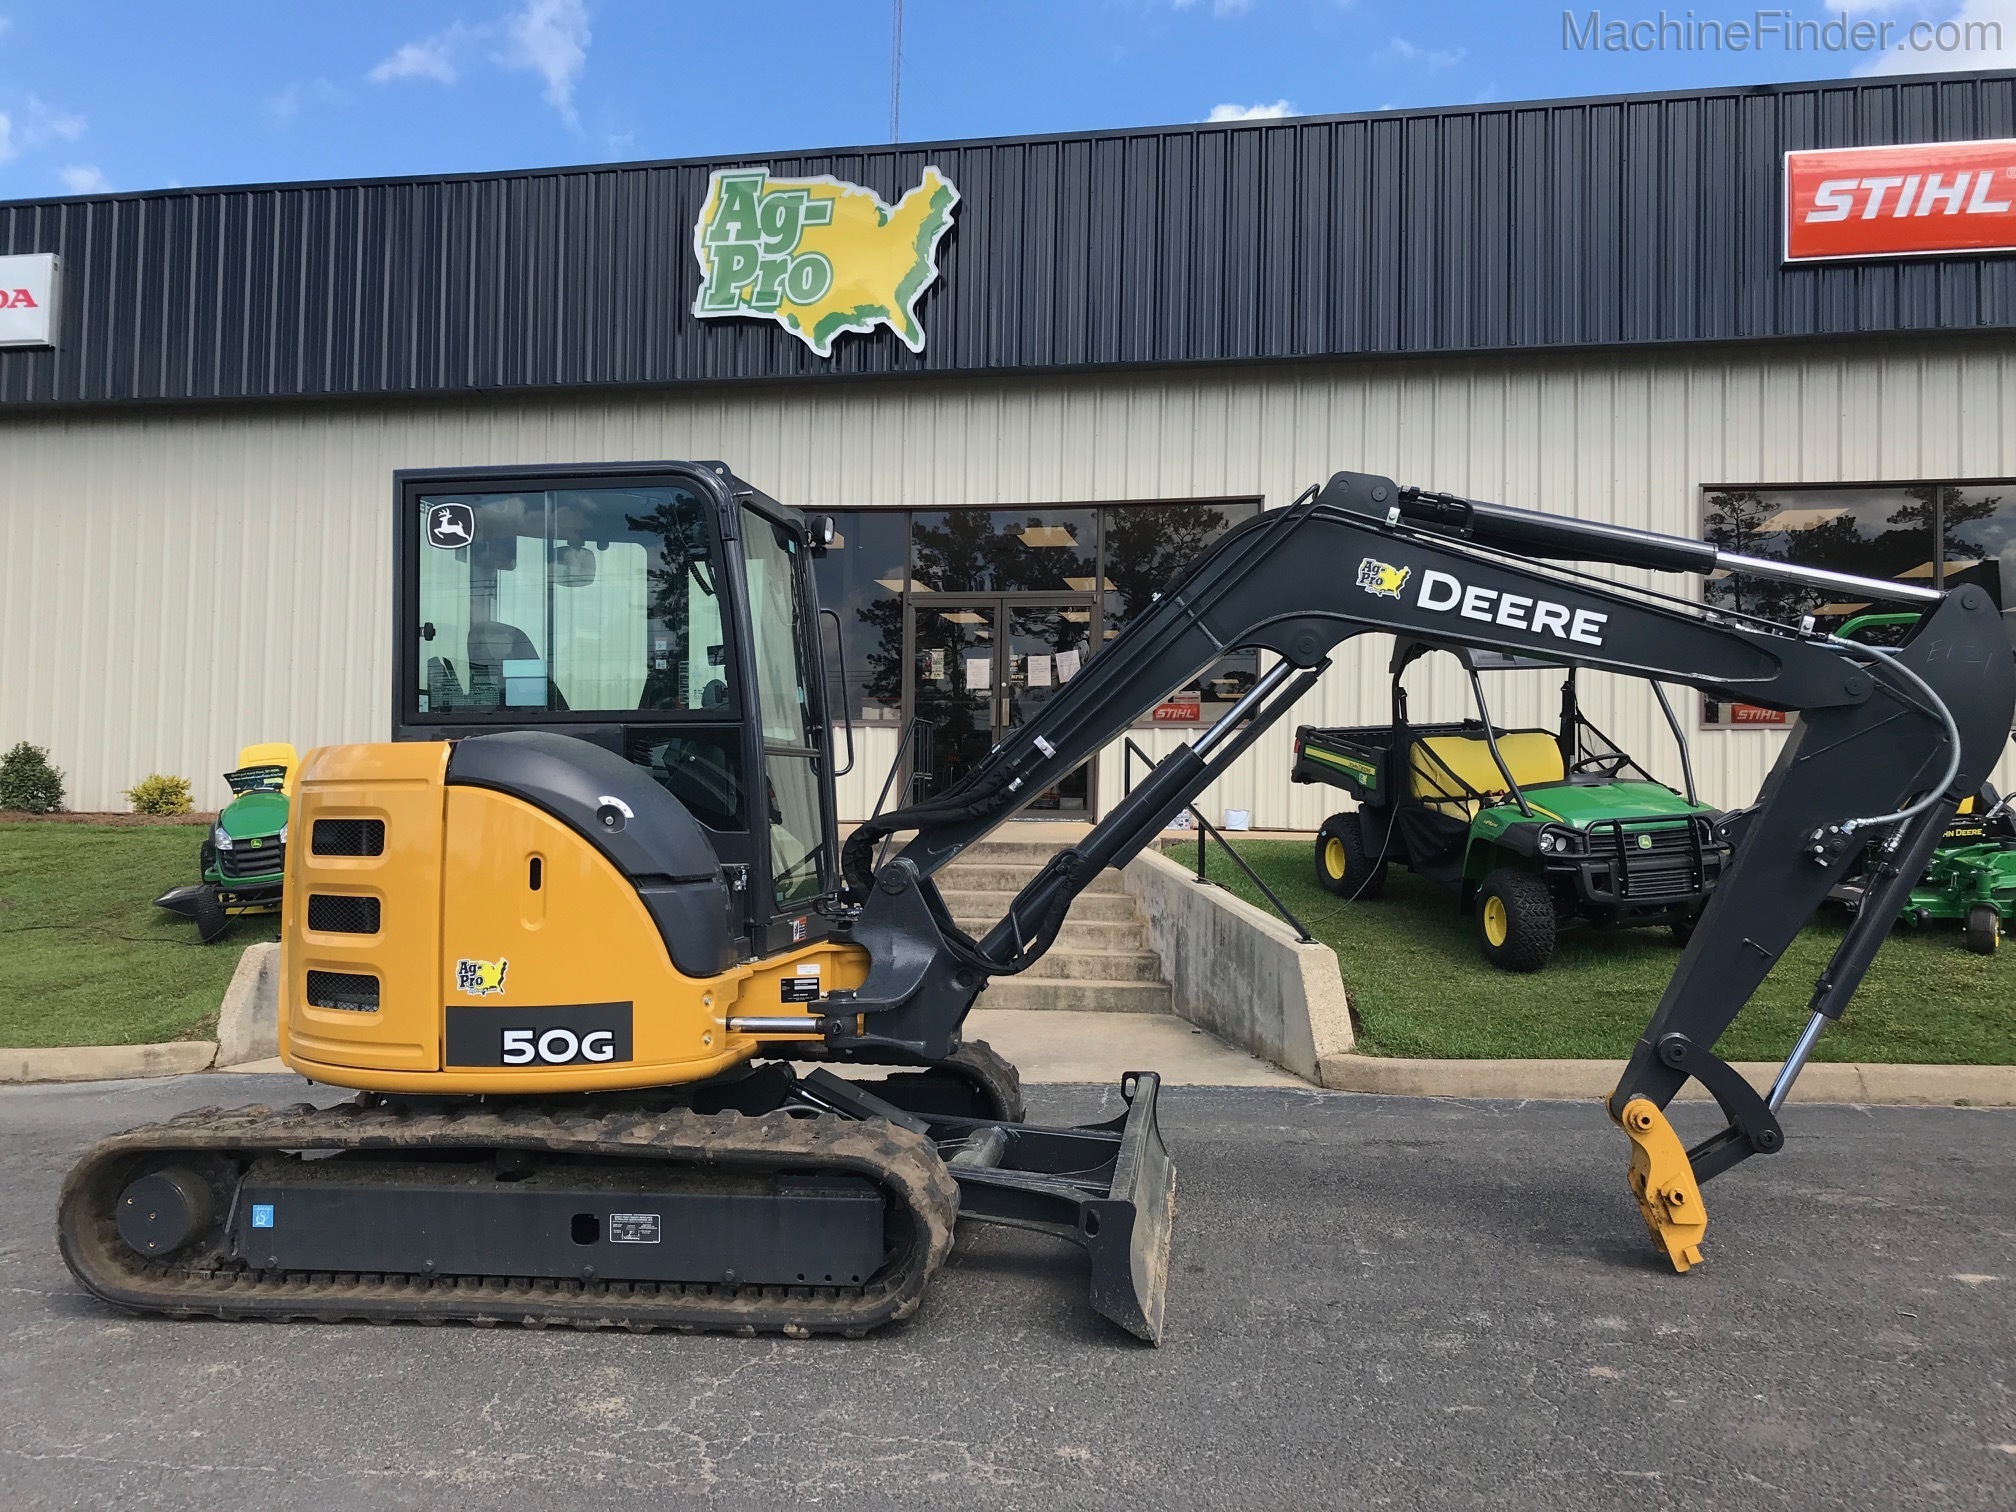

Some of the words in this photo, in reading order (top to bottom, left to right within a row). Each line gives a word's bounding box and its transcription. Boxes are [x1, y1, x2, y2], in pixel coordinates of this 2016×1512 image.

[705, 175, 832, 257] Ag-
[704, 243, 832, 310] Pro
[1359, 572, 1384, 586] Pro
[1416, 569, 1609, 647] DEERE
[1156, 708, 1195, 719] STIHL
[1736, 709, 1780, 720] STIHL
[1955, 828, 1983, 837] DEERE
[459, 974, 484, 988] Pro
[503, 1029, 614, 1064] 50G
